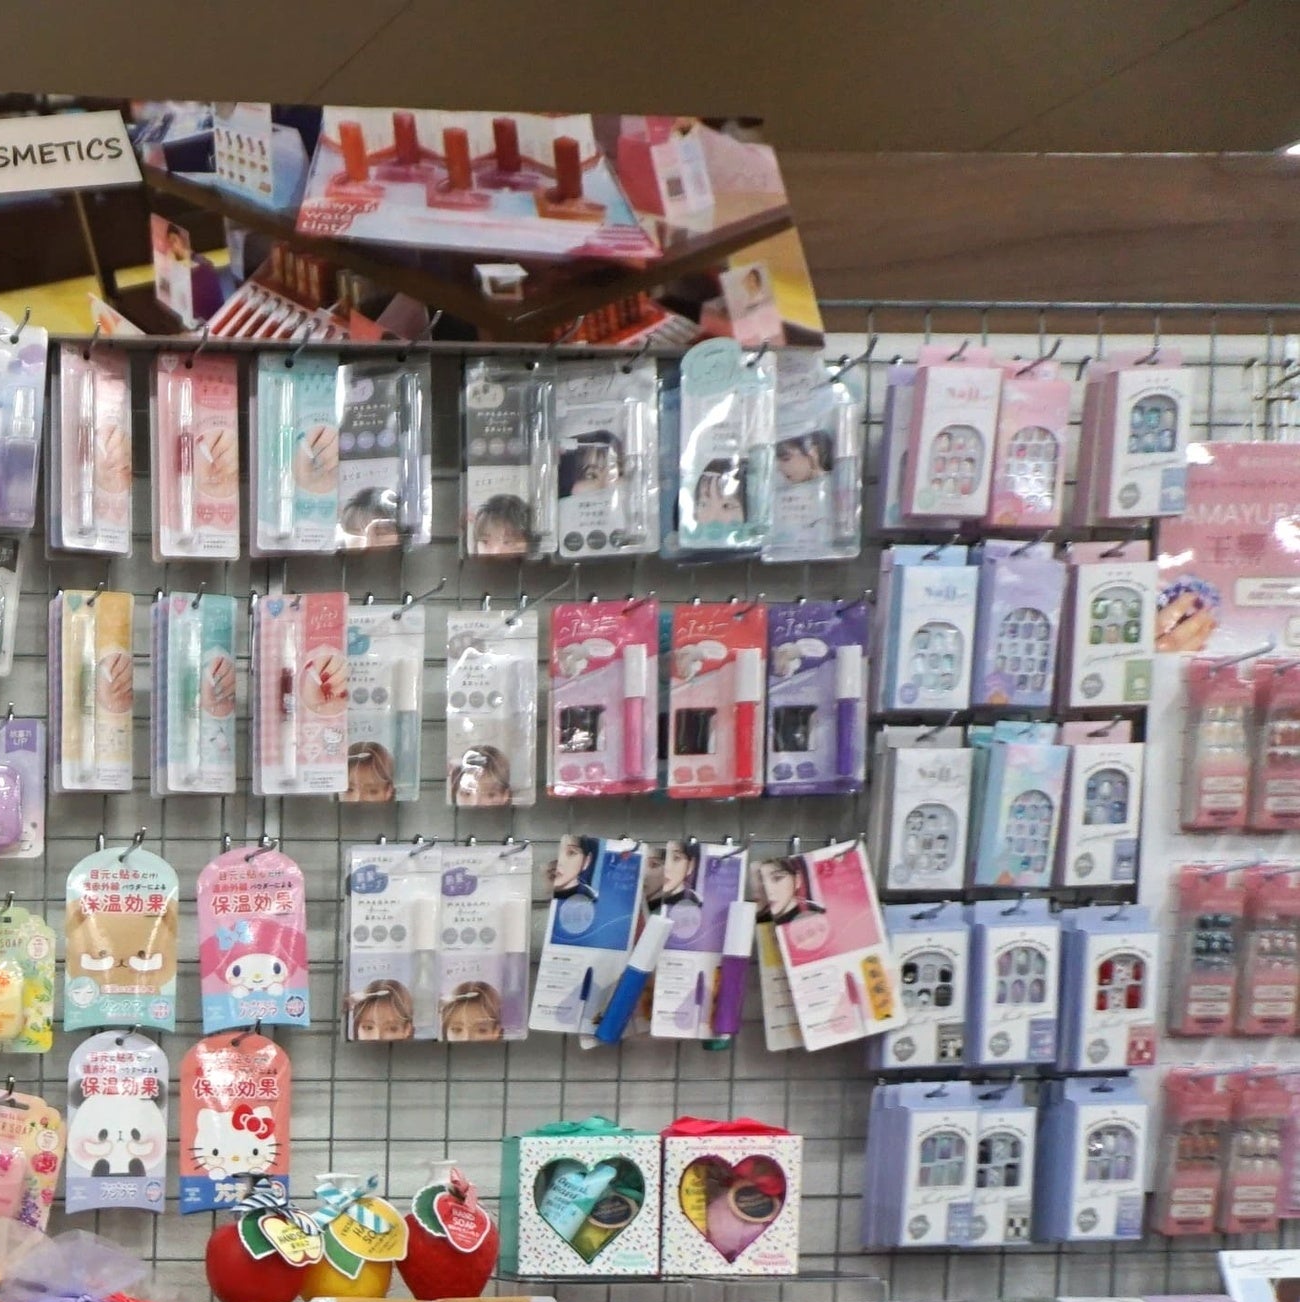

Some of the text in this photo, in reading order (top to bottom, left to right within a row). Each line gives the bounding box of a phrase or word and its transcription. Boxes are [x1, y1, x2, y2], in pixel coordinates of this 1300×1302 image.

[83, 894, 167, 913] 保温効果
[212, 892, 294, 913] 保温効果
[0, 938, 23, 948] SOAP
[81, 1077, 159, 1097] 保温効果
